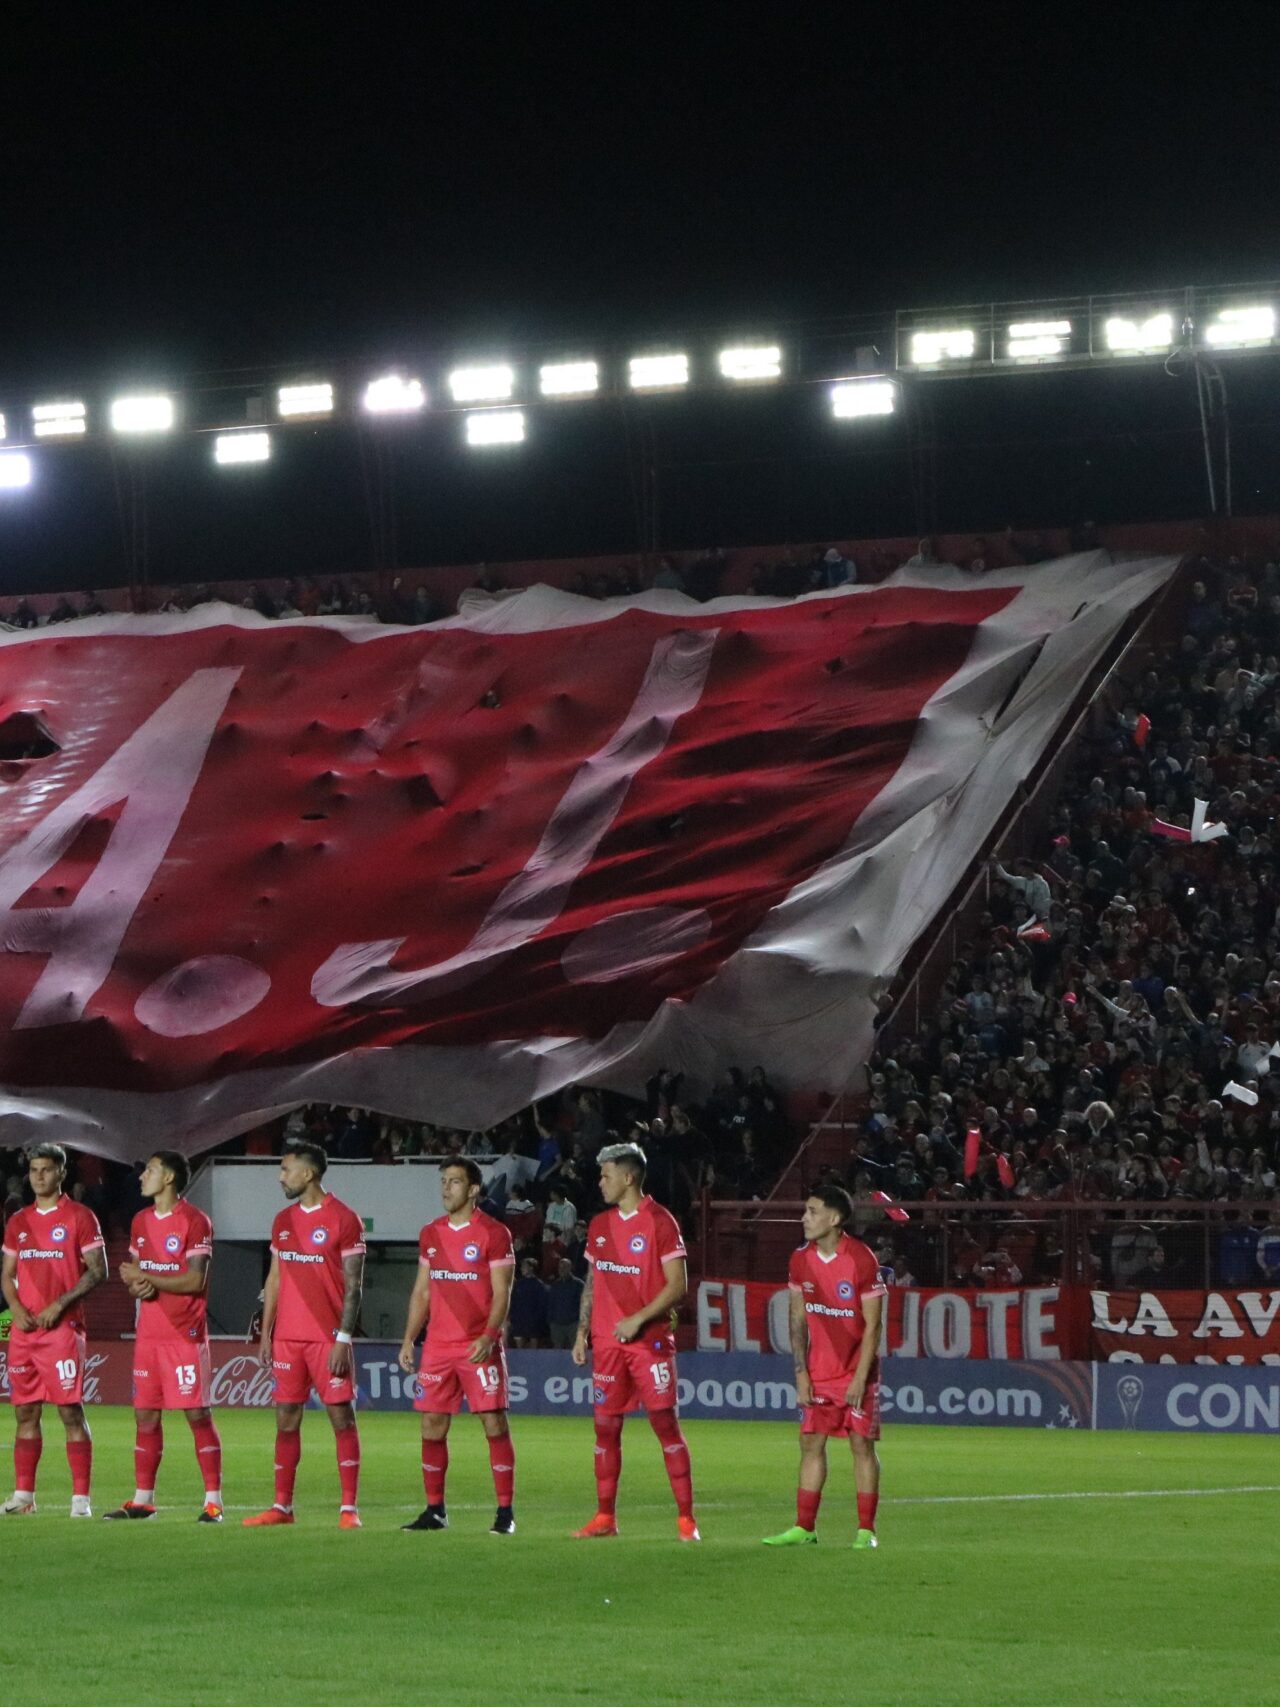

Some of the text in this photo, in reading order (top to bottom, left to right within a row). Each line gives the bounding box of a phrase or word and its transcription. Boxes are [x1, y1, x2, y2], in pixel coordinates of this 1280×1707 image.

[1089, 1290, 1179, 1338] LA
[55, 1359, 77, 1380] 10
[175, 1364, 197, 1386] 13
[476, 1365, 500, 1388] 18
[649, 1362, 671, 1386] 15
